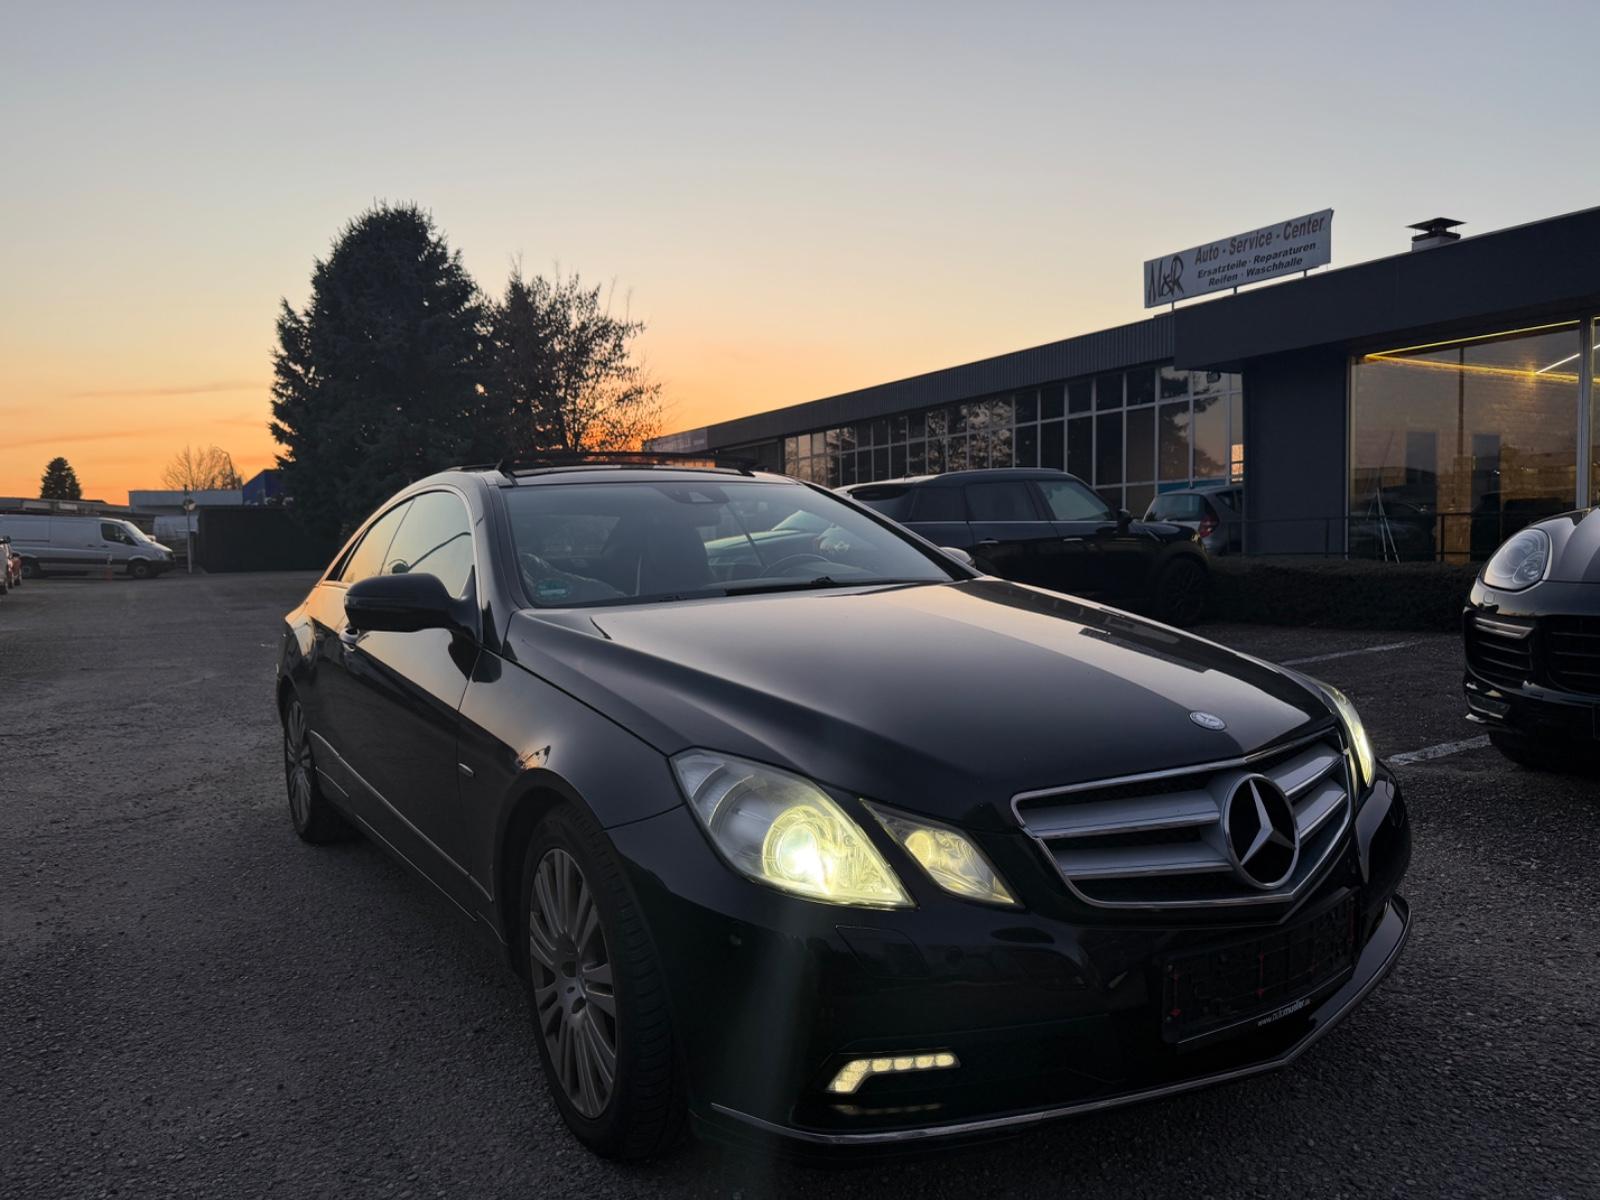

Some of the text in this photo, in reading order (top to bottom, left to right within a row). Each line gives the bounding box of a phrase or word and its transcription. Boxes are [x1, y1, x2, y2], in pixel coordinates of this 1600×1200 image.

[1194, 215, 1325, 266] Auto Service Center
[1197, 242, 1316, 279] Ersatzteile Reparaturen
[1208, 257, 1303, 288] Reifen Waschhalle
